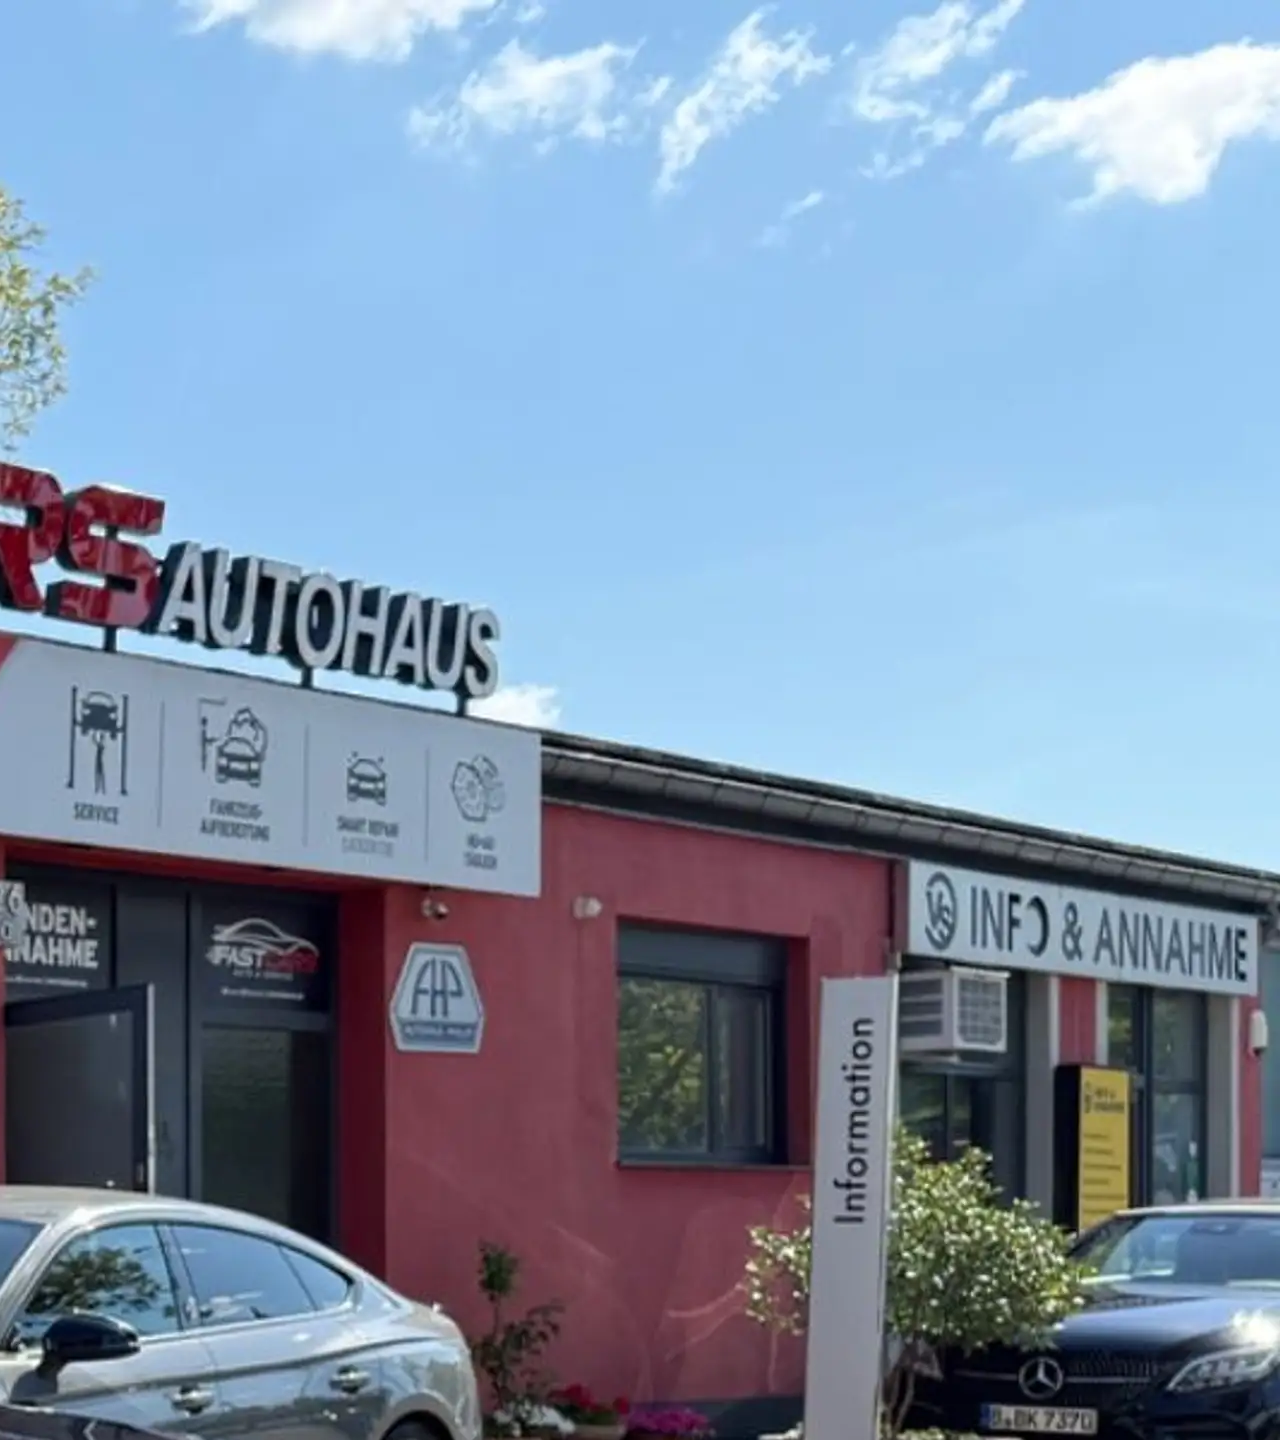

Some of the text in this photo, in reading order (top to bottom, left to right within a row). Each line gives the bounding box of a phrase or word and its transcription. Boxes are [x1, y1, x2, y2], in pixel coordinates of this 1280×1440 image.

[156, 541, 501, 698] AUTOHAUS
[73, 801, 120, 825] SERVICE
[21, 902, 97, 936] NDEN-
[970, 886, 1248, 983] INFO & ANNAHME
[833, 1016, 875, 1225] Information
